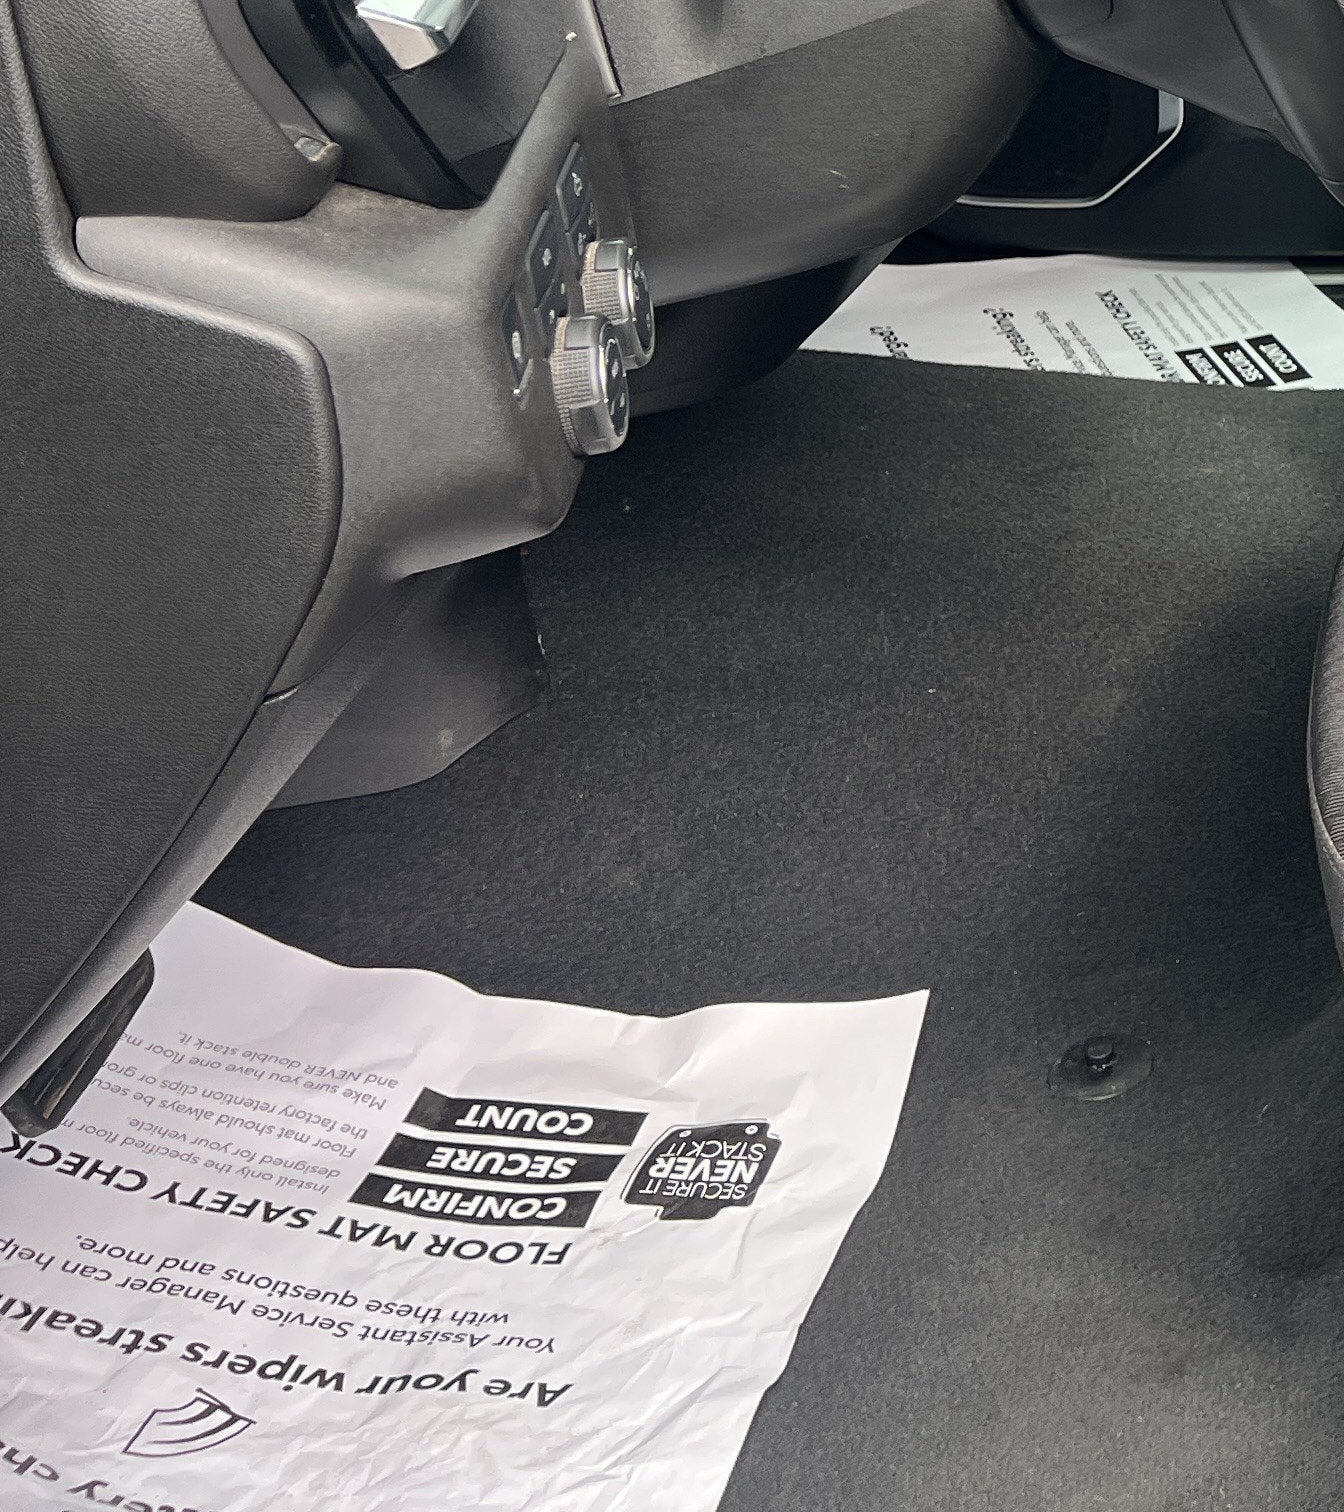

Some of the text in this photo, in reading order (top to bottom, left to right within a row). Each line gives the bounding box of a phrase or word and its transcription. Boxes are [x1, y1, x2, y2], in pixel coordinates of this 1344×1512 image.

[1259, 343, 1297, 373] COUNT
[195, 1036, 240, 1056] stack
[240, 1048, 302, 1069] double
[118, 1030, 386, 1110] Make sure you have one floor ma
[136, 1073, 156, 1086] or
[302, 1062, 362, 1082] NEVER
[362, 1072, 398, 1090] and
[160, 1077, 198, 1096] clips
[200, 1087, 276, 1113] retention
[90, 1077, 355, 1158] Floor mat should always be secu
[278, 1103, 336, 1133] factory
[336, 1120, 366, 1139] the
[454, 1102, 594, 1134] COUNT
[76, 1122, 118, 1142] floor
[112, 1134, 200, 1165] specified
[125, 1116, 340, 1179] designed for your vehicle.
[658, 1138, 766, 1158] STACK IT
[202, 1158, 232, 1174] the
[234, 1164, 273, 1181] only
[424, 1144, 576, 1180] SECURE
[645, 1155, 760, 1182] NEVER
[0, 1129, 572, 1264] FLOOR MAT SAFETY CHECK
[274, 1174, 328, 1194] Install
[637, 1178, 748, 1200] SECURE IT
[380, 1182, 568, 1219] CONFIRM
[60, 1259, 111, 1281] can
[74, 1234, 508, 1326] with these questions and more.
[114, 1276, 244, 1314] Manager
[250, 1304, 353, 1337] Service
[356, 1324, 489, 1348] Assistant
[490, 1334, 555, 1353] Your
[0, 1293, 573, 1406] Are your wipers streaki
